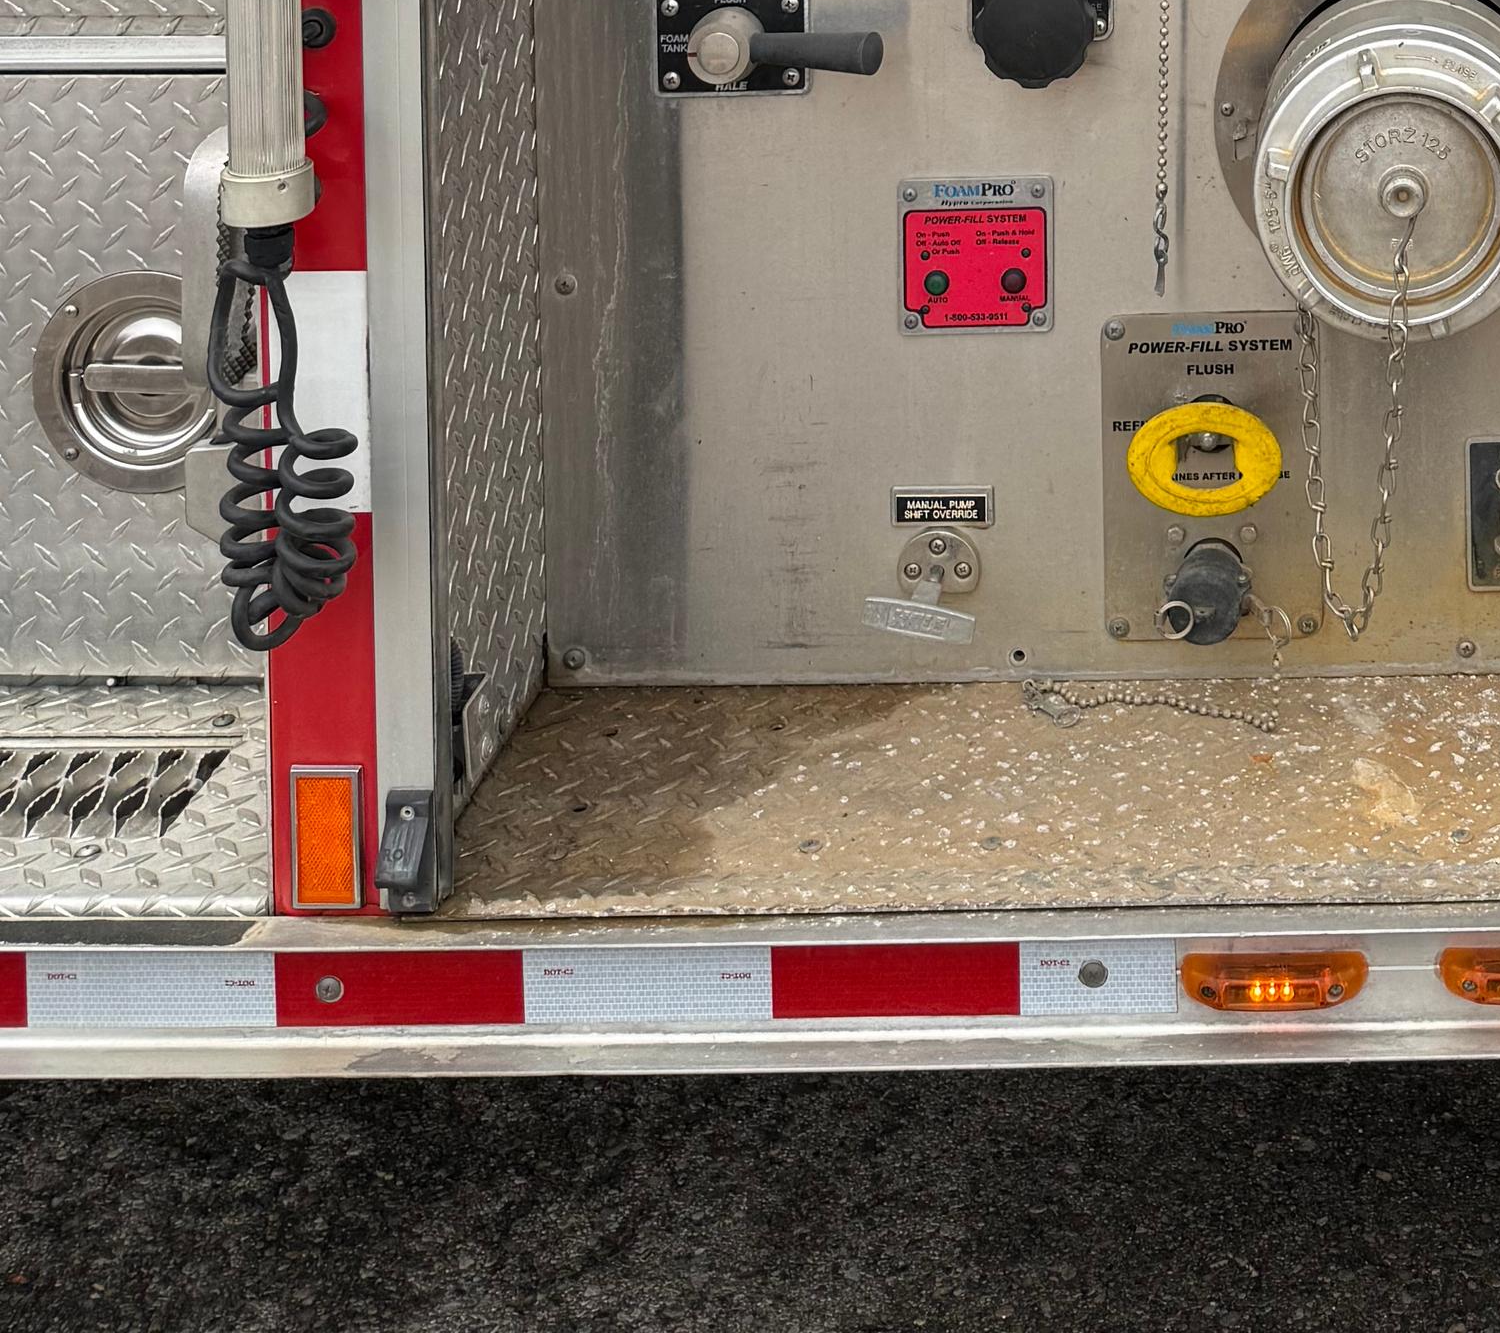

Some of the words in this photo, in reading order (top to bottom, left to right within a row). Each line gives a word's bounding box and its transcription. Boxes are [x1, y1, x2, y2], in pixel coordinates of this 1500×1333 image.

[661, 34, 689, 44] FOAM
[661, 44, 688, 53] TANK
[1354, 126, 1417, 163] STORZ
[1421, 132, 1452, 161] 125
[924, 215, 985, 225] POWER-FILL
[987, 214, 1027, 223] SYSTEM
[1128, 341, 1223, 354] POWER-FILL
[1228, 339, 1293, 351] SYSTEM
[1187, 364, 1234, 375] FLUSH
[1202, 472, 1236, 480] AFTER
[907, 500, 946, 509] MANUAL
[949, 500, 976, 509] PUMP
[904, 510, 930, 519] SHIFT
[933, 510, 978, 519] OVERRIDE
